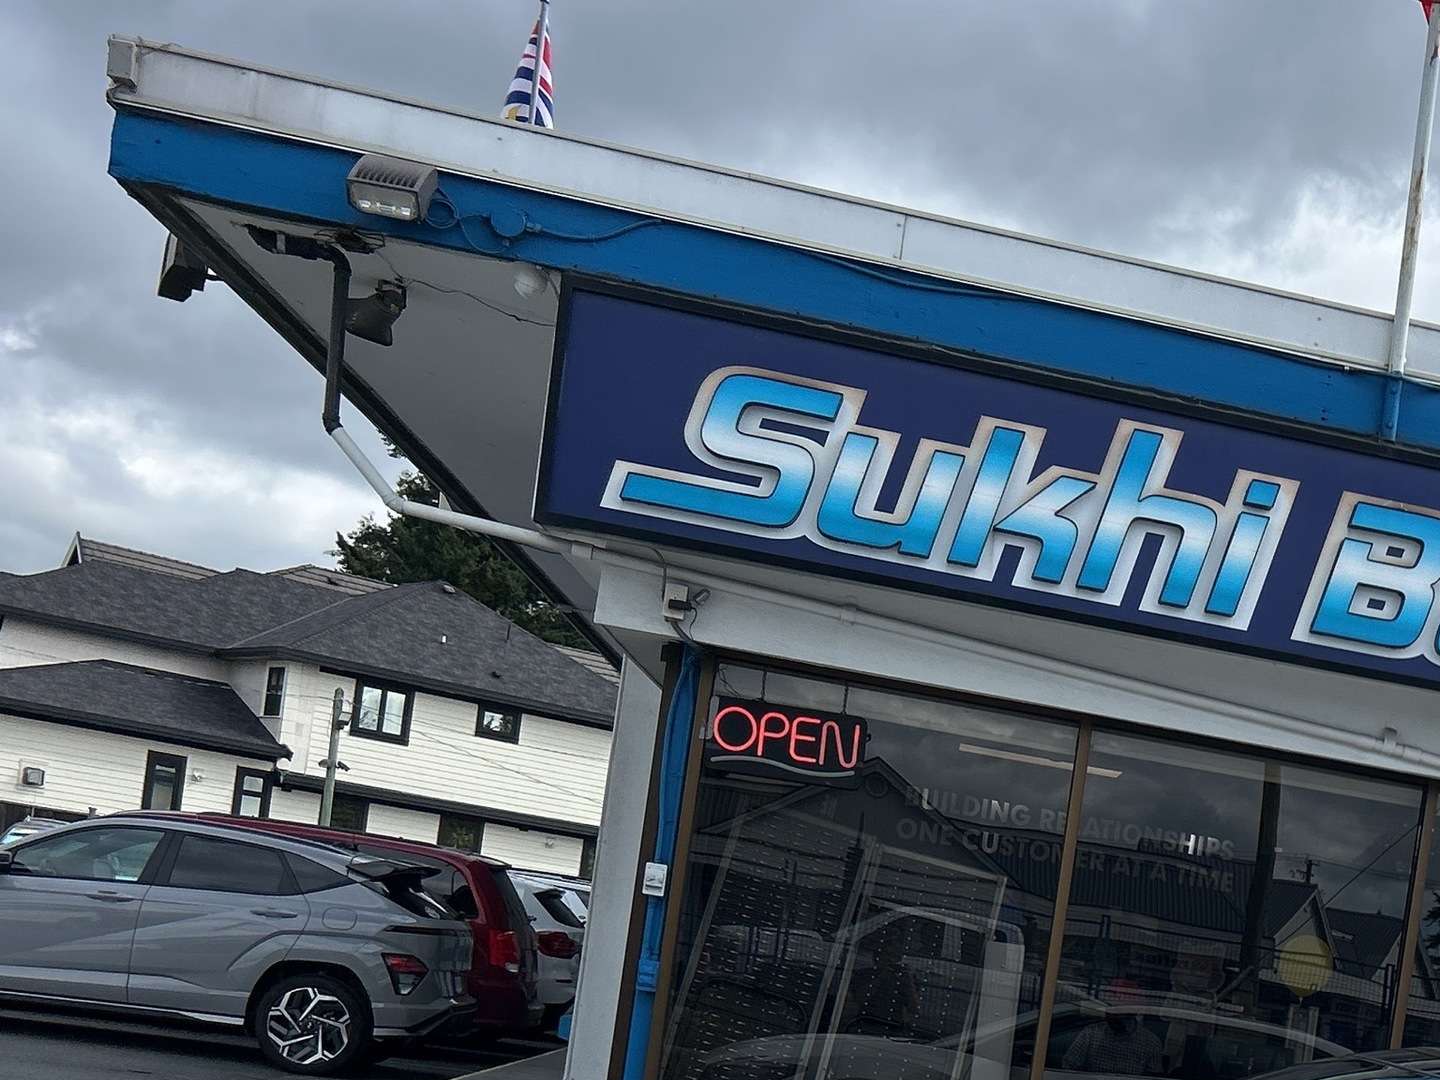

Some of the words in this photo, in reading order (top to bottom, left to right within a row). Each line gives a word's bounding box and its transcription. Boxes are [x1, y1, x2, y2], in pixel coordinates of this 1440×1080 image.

[602, 366, 1298, 630] Sukhi
[711, 705, 861, 768] OPEN
[896, 818, 951, 846] ONE
[1176, 864, 1234, 893] TIME
[905, 784, 1032, 826] BUILDING
[1040, 808, 1235, 859] REATIONSHIPS
